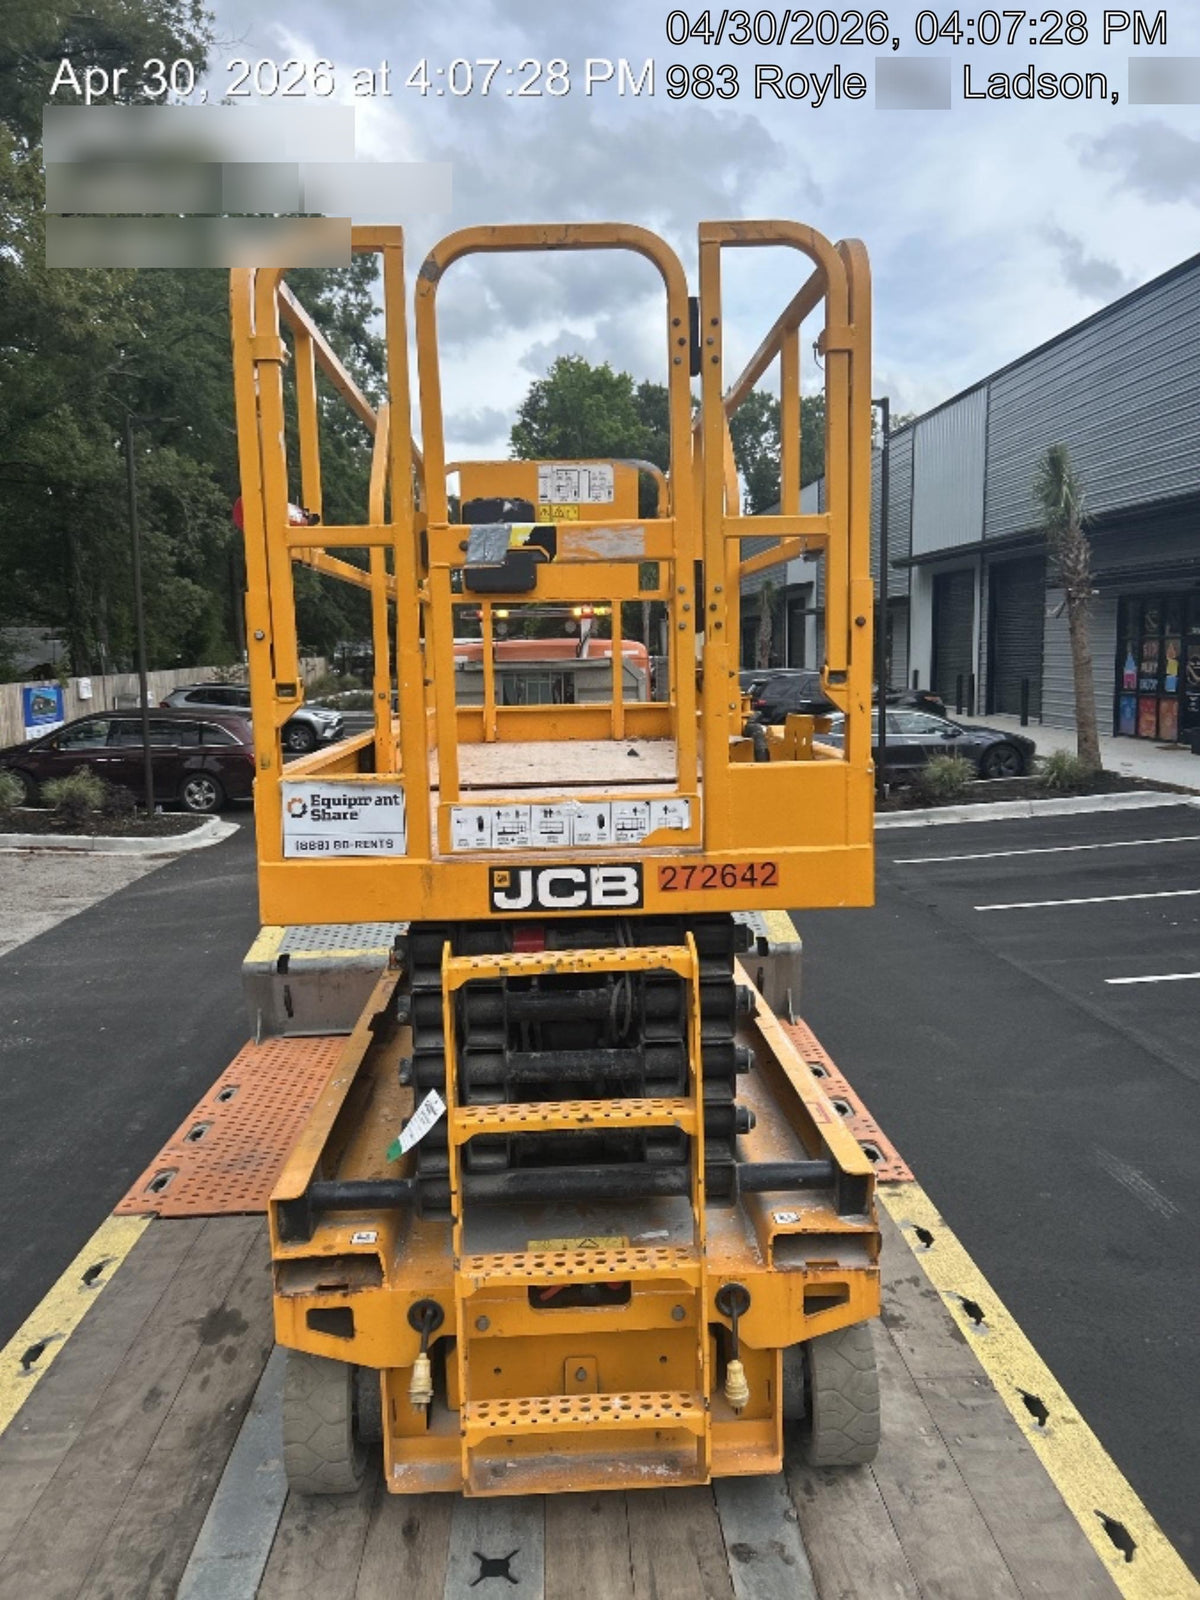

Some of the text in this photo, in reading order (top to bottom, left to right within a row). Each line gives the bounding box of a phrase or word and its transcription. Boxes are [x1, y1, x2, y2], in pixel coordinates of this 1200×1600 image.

[310, 808, 359, 821] Share
[493, 867, 640, 910] JCB
[661, 861, 778, 891] 272642
